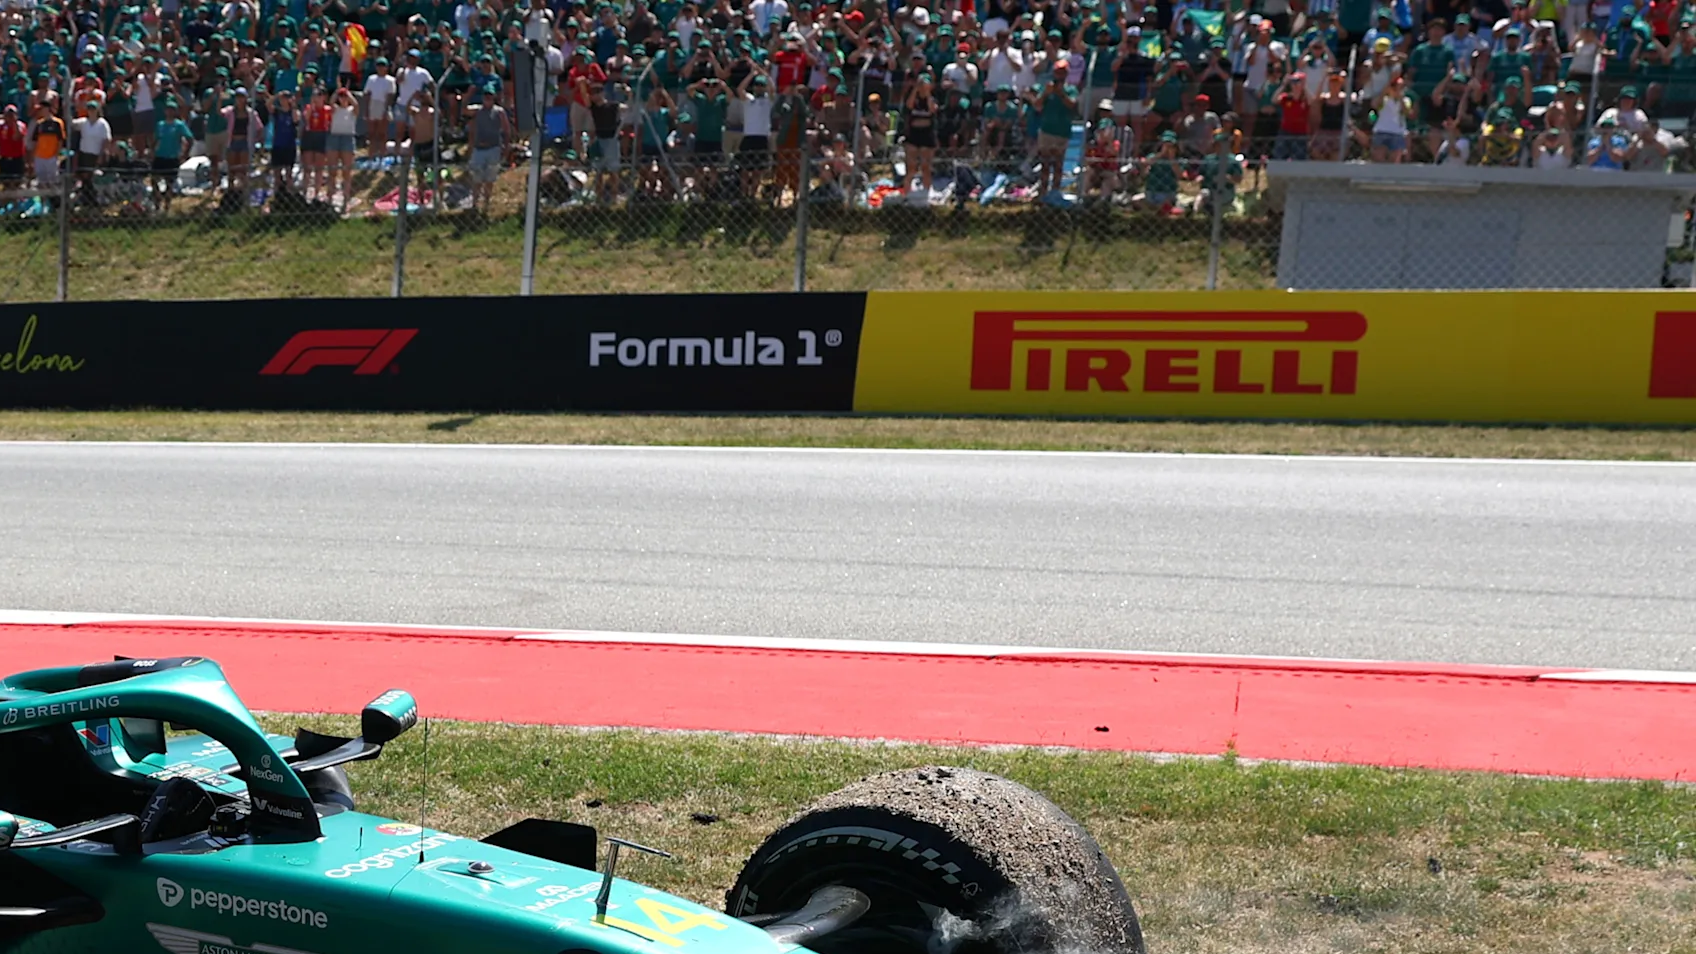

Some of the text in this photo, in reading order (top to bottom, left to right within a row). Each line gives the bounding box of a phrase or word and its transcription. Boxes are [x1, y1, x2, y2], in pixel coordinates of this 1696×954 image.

[589, 329, 784, 366] Formula
[970, 310, 1368, 395] PIRELLI
[24, 695, 120, 720] BREITLING
[249, 765, 284, 784] NexGen
[267, 804, 303, 820] Valvoline
[324, 832, 462, 878] cognizant
[190, 887, 328, 929] pepperstone
[590, 897, 729, 948] 14
